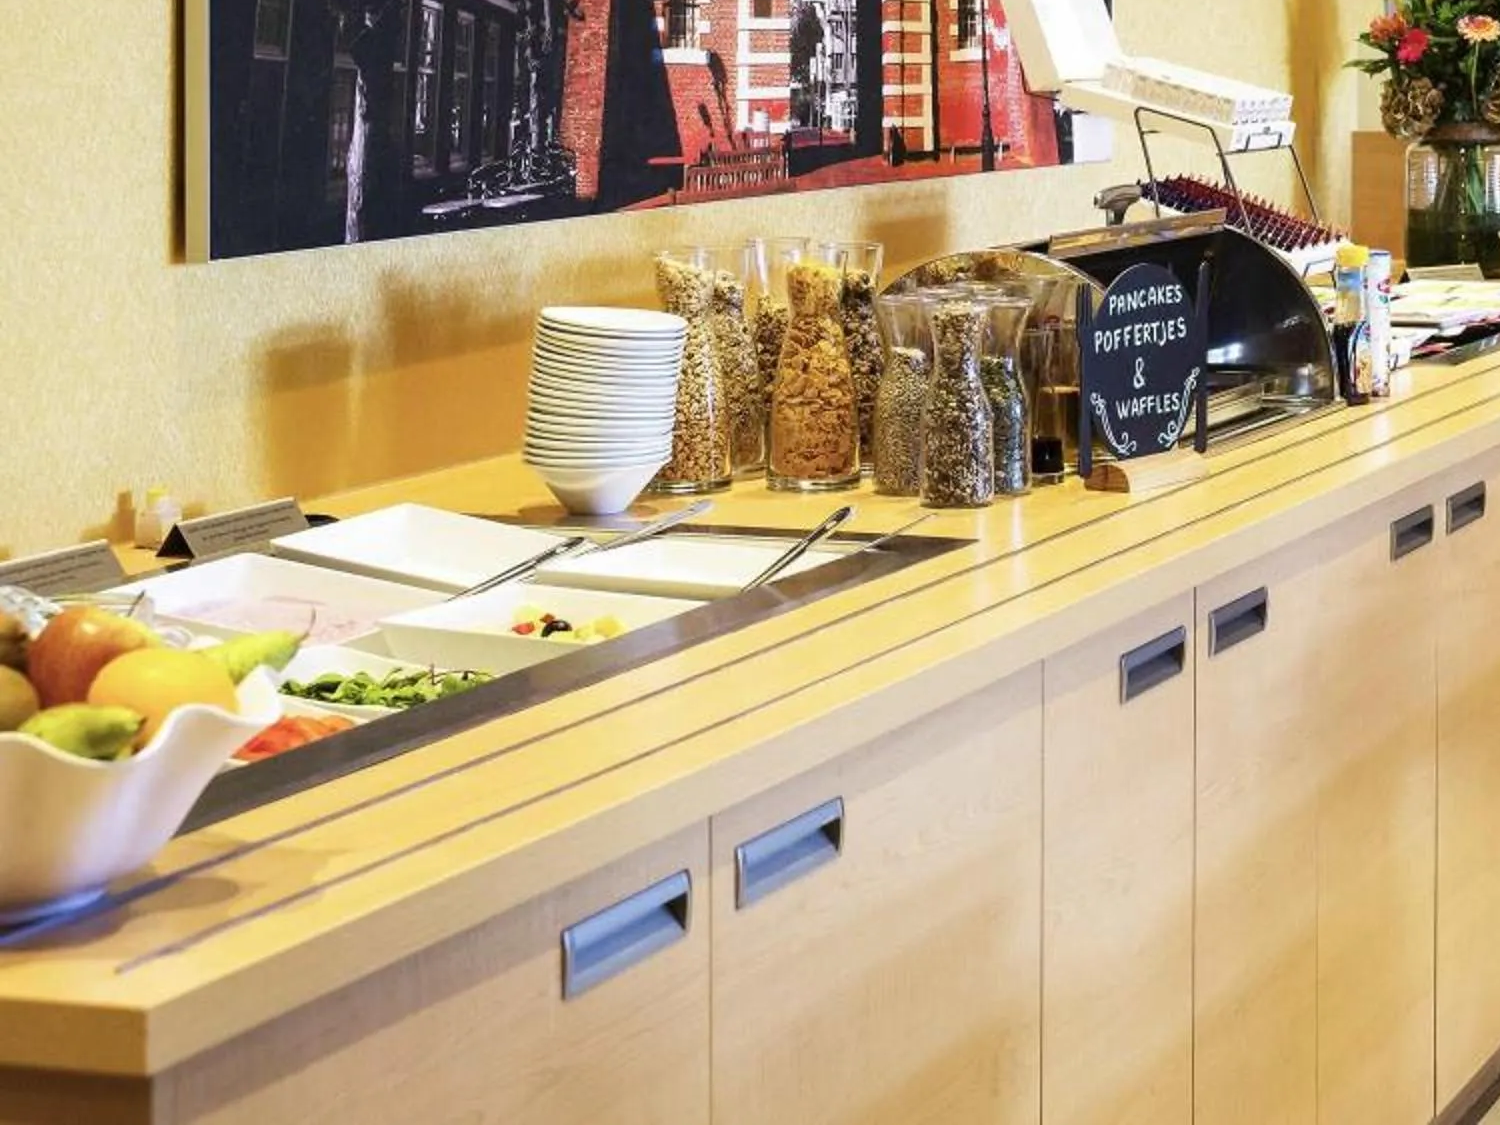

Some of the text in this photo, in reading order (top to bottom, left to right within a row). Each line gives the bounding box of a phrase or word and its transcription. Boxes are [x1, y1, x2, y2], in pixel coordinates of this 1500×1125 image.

[1109, 284, 1183, 315] PANCAKES
[1094, 316, 1187, 354] POFFERTJES
[1133, 357, 1145, 389] &
[1116, 392, 1180, 420] WAFFLES
